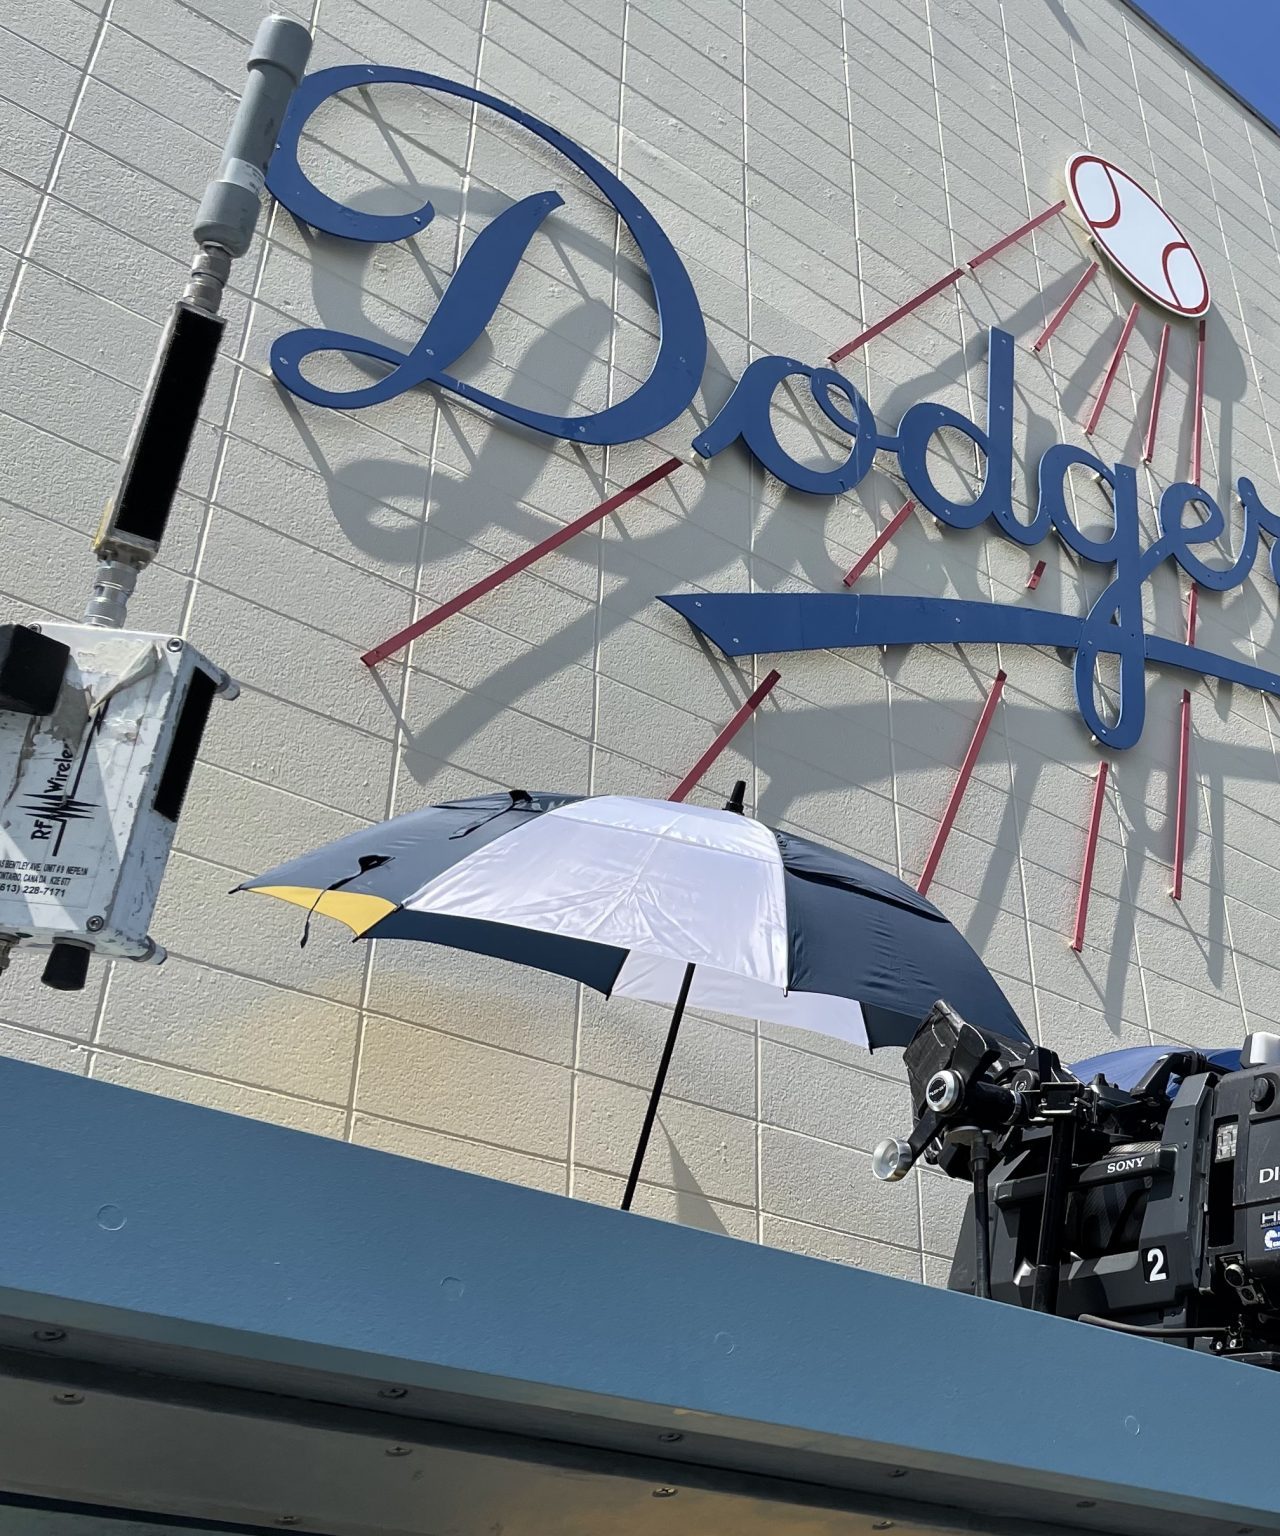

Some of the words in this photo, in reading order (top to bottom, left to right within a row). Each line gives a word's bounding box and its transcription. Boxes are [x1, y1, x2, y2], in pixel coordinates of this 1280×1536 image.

[31, 820, 53, 840] RF
[44, 739, 74, 794] Wirele
[1107, 1157, 1145, 1174] SONY
[1147, 1248, 1167, 1282] 2
